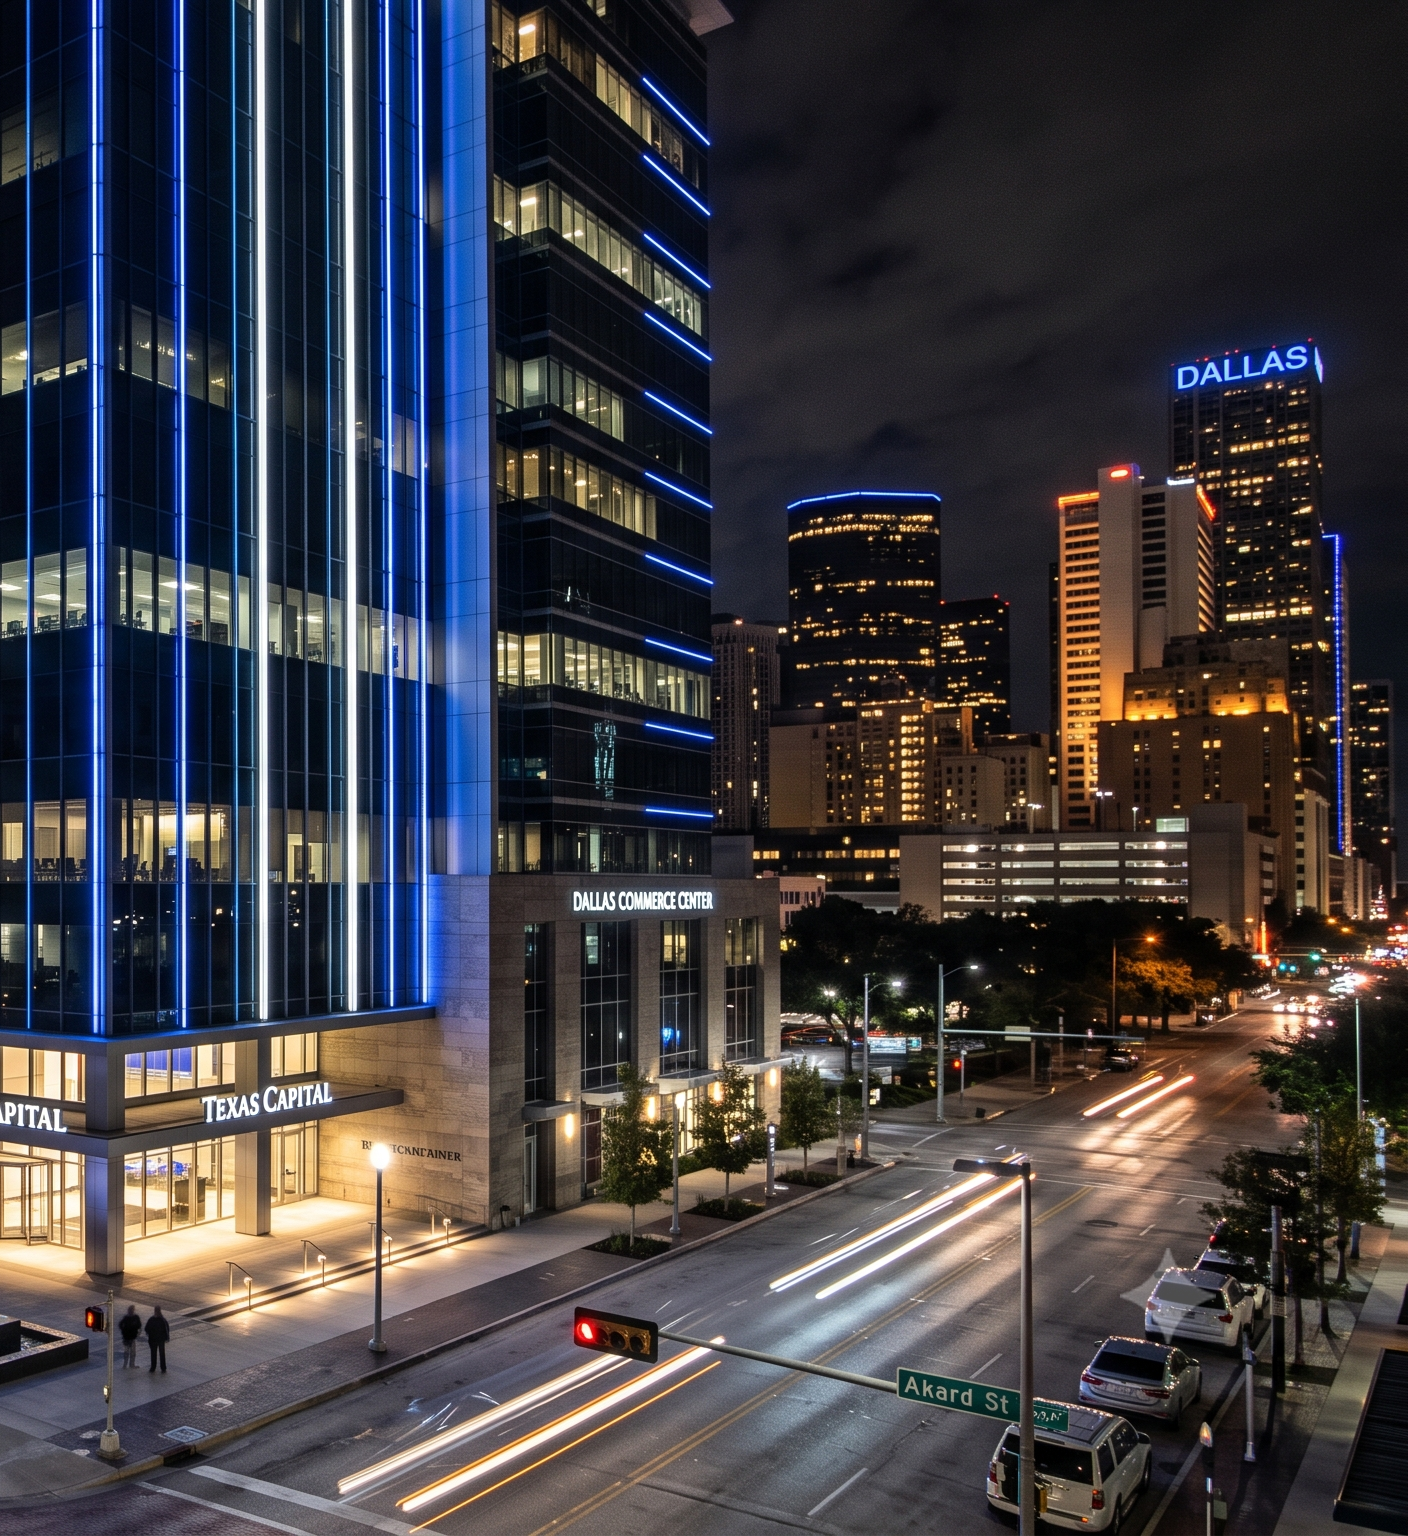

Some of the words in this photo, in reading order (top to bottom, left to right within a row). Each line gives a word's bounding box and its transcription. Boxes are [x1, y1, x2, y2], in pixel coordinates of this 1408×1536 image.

[1177, 345, 1308, 389] DALLAS
[573, 891, 616, 911] DALLAS
[618, 891, 676, 910] COMMERCE
[678, 891, 713, 910] CENTER
[202, 1092, 260, 1123] TEXAS
[263, 1082, 332, 1112] CAPITAL
[904, 1376, 973, 1407] Akard
[985, 1392, 1009, 1414] St
